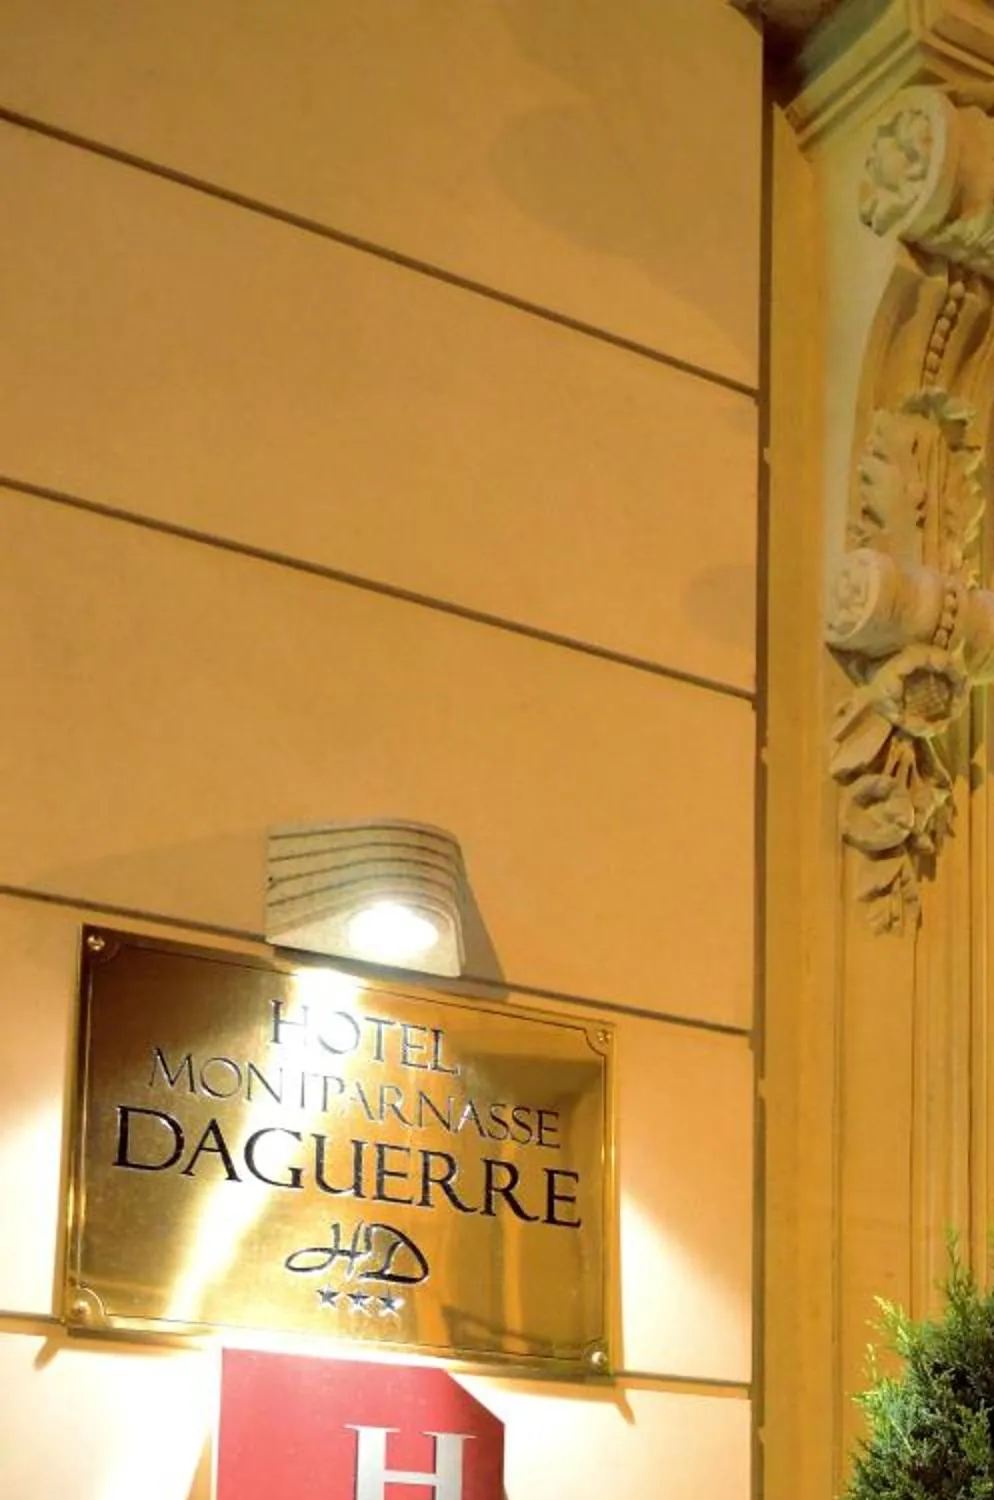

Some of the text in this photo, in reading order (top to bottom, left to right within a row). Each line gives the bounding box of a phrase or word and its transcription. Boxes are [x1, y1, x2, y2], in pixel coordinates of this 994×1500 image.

[269, 998, 461, 1076] HOTEL
[149, 1047, 562, 1149] MONTPARNASSE
[112, 1104, 583, 1229] DAGUERRE
